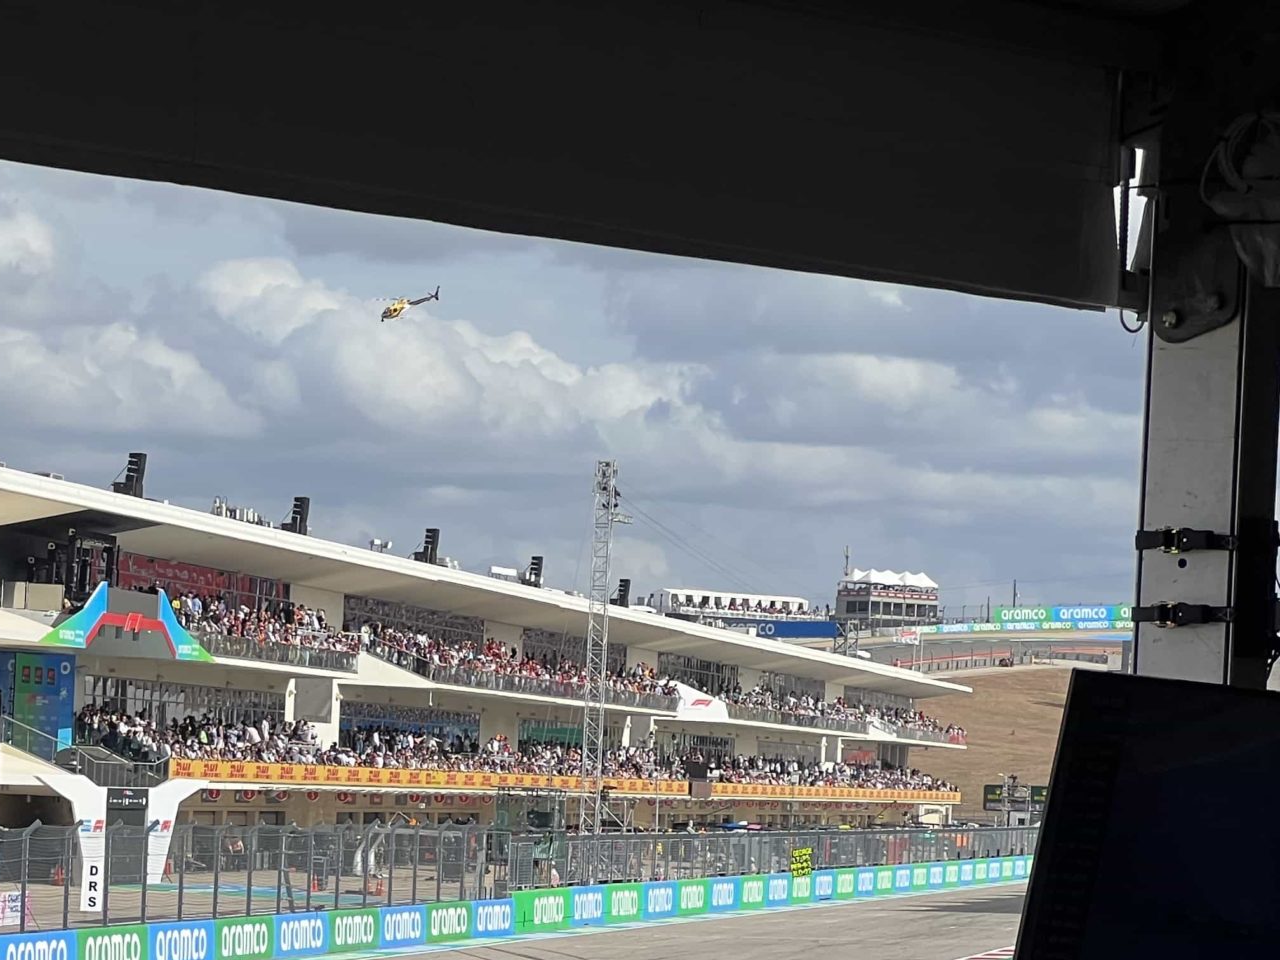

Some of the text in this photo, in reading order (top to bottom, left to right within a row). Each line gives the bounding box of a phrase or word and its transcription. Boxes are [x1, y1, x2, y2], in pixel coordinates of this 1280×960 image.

[1001, 608, 1047, 620] aramco
[1060, 606, 1107, 619] aramco
[1078, 619, 1108, 630] aramco
[972, 622, 1001, 632] aramco
[574, 893, 603, 920] aramco
[611, 890, 638, 916] aramco
[648, 887, 673, 913] aramco
[681, 885, 704, 909] aramco
[712, 882, 734, 906] aramco
[431, 907, 468, 936] aramco
[477, 904, 511, 932] aramco
[534, 895, 564, 925] aramco
[280, 918, 323, 951] aramco
[335, 914, 374, 946] aramco
[384, 910, 421, 941] aramco
[221, 922, 268, 957] aramco
